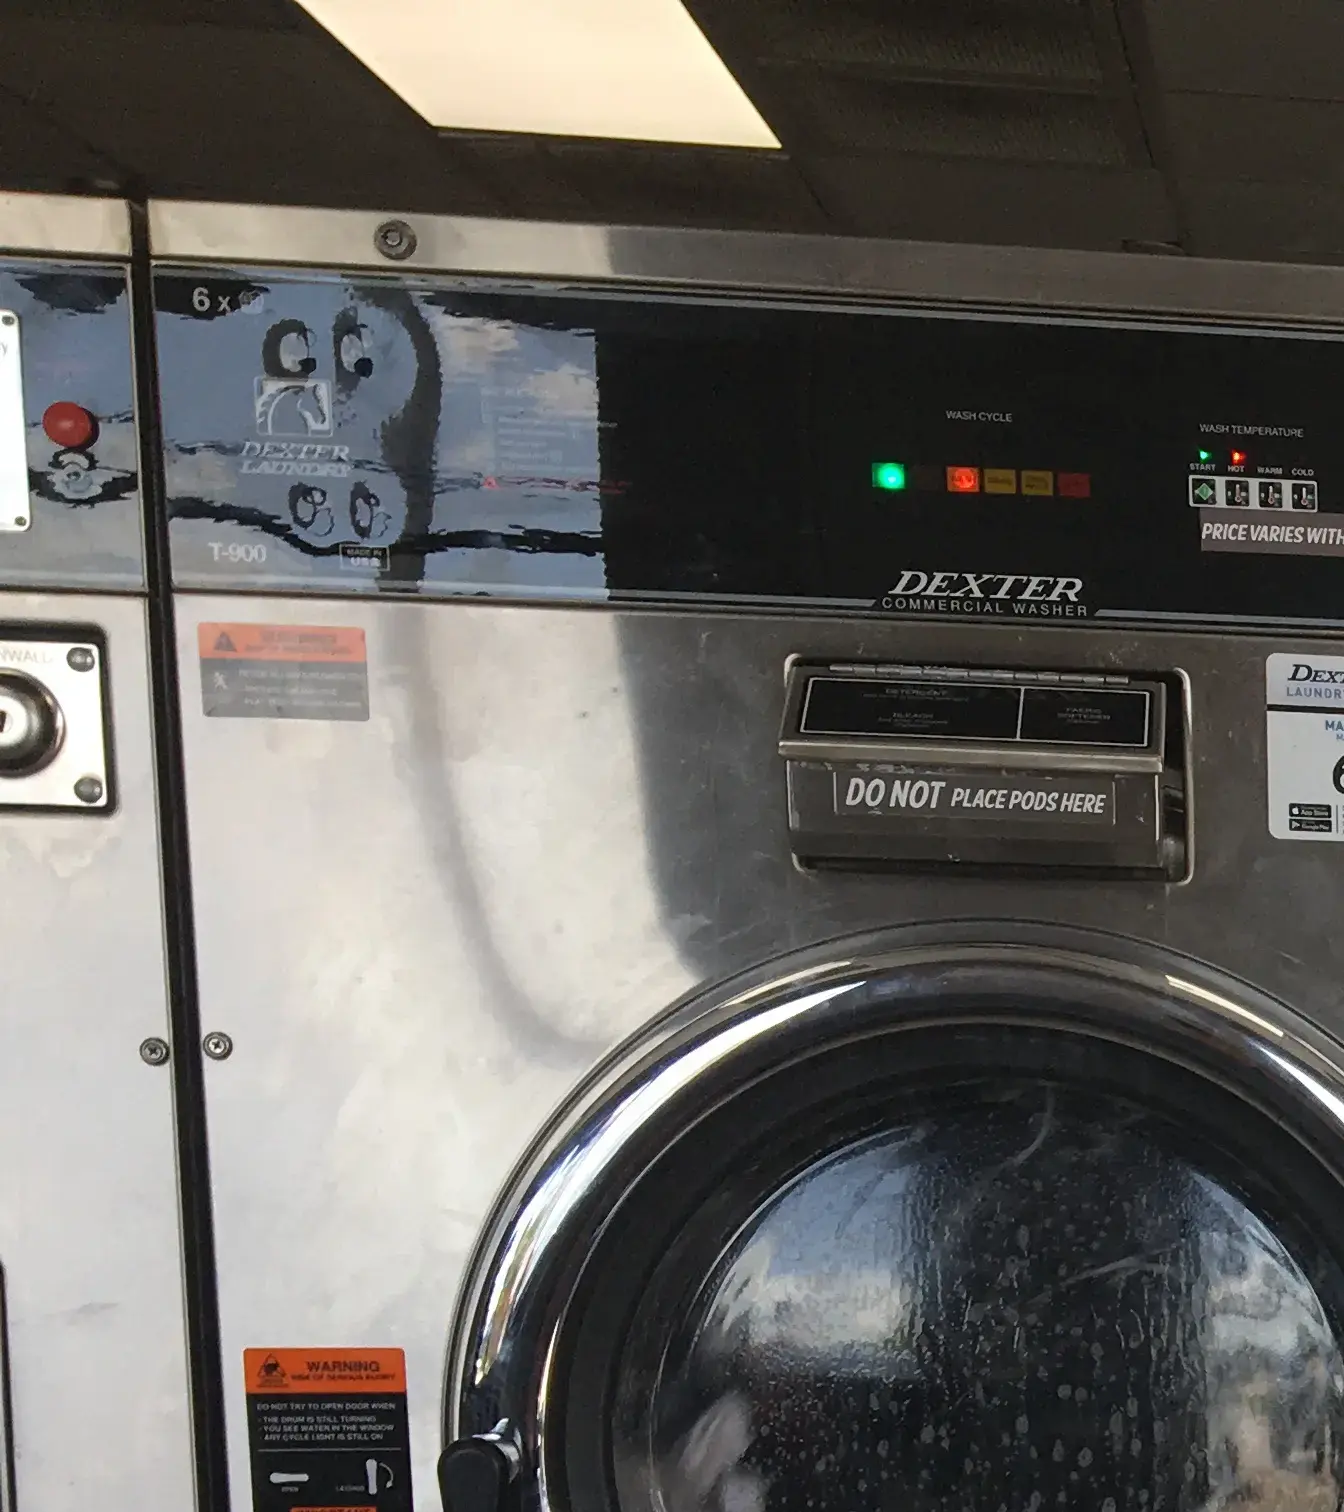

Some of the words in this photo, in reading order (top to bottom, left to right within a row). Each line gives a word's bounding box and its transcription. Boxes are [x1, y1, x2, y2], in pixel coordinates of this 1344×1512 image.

[192, 287, 211, 312] 6
[217, 295, 231, 312] x
[946, 410, 976, 421] WASH
[978, 411, 1013, 423] CYCLE
[1199, 423, 1229, 434] WASH
[1231, 425, 1304, 438] TEMPERATURE
[241, 441, 350, 461] DEXTER
[1189, 462, 1216, 472] START
[1227, 464, 1244, 473] HOT
[1257, 466, 1283, 475] WARM
[1291, 468, 1314, 477] COLD
[1201, 523, 1248, 541] PRICE
[1250, 524, 1304, 544] VARIES
[208, 542, 267, 563] T-900
[888, 570, 1083, 602] DEXTER
[882, 597, 1004, 613] COMMERCIAL
[1012, 603, 1087, 617] WASHER
[845, 777, 885, 808] DO
[889, 779, 946, 809] NOT
[950, 787, 1007, 809] PLACE
[1009, 789, 1057, 812] PODS
[1059, 792, 1106, 814] HERE
[306, 1361, 380, 1372] WARNING
